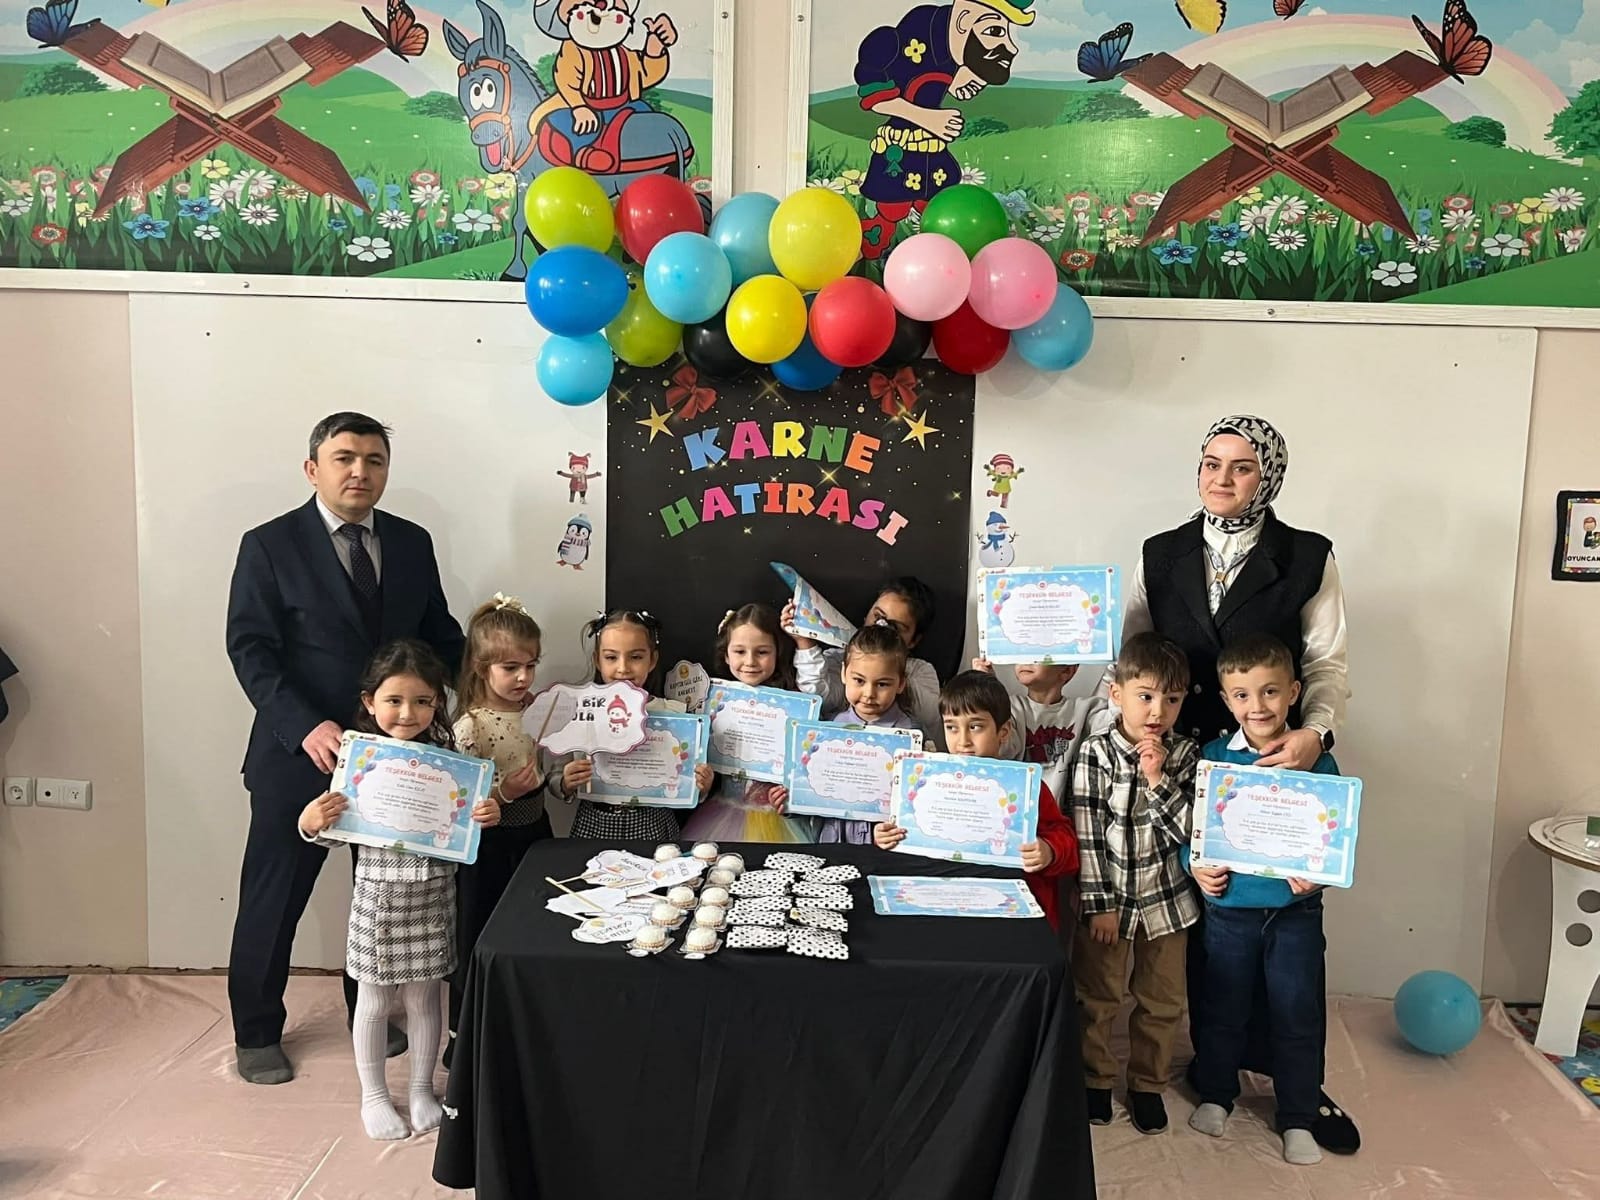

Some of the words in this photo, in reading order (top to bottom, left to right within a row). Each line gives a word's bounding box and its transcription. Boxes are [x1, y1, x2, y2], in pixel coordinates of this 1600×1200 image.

[682, 420, 881, 474] KARNE
[659, 482, 909, 546] HATIRASI
[582, 697, 606, 708] BİR
